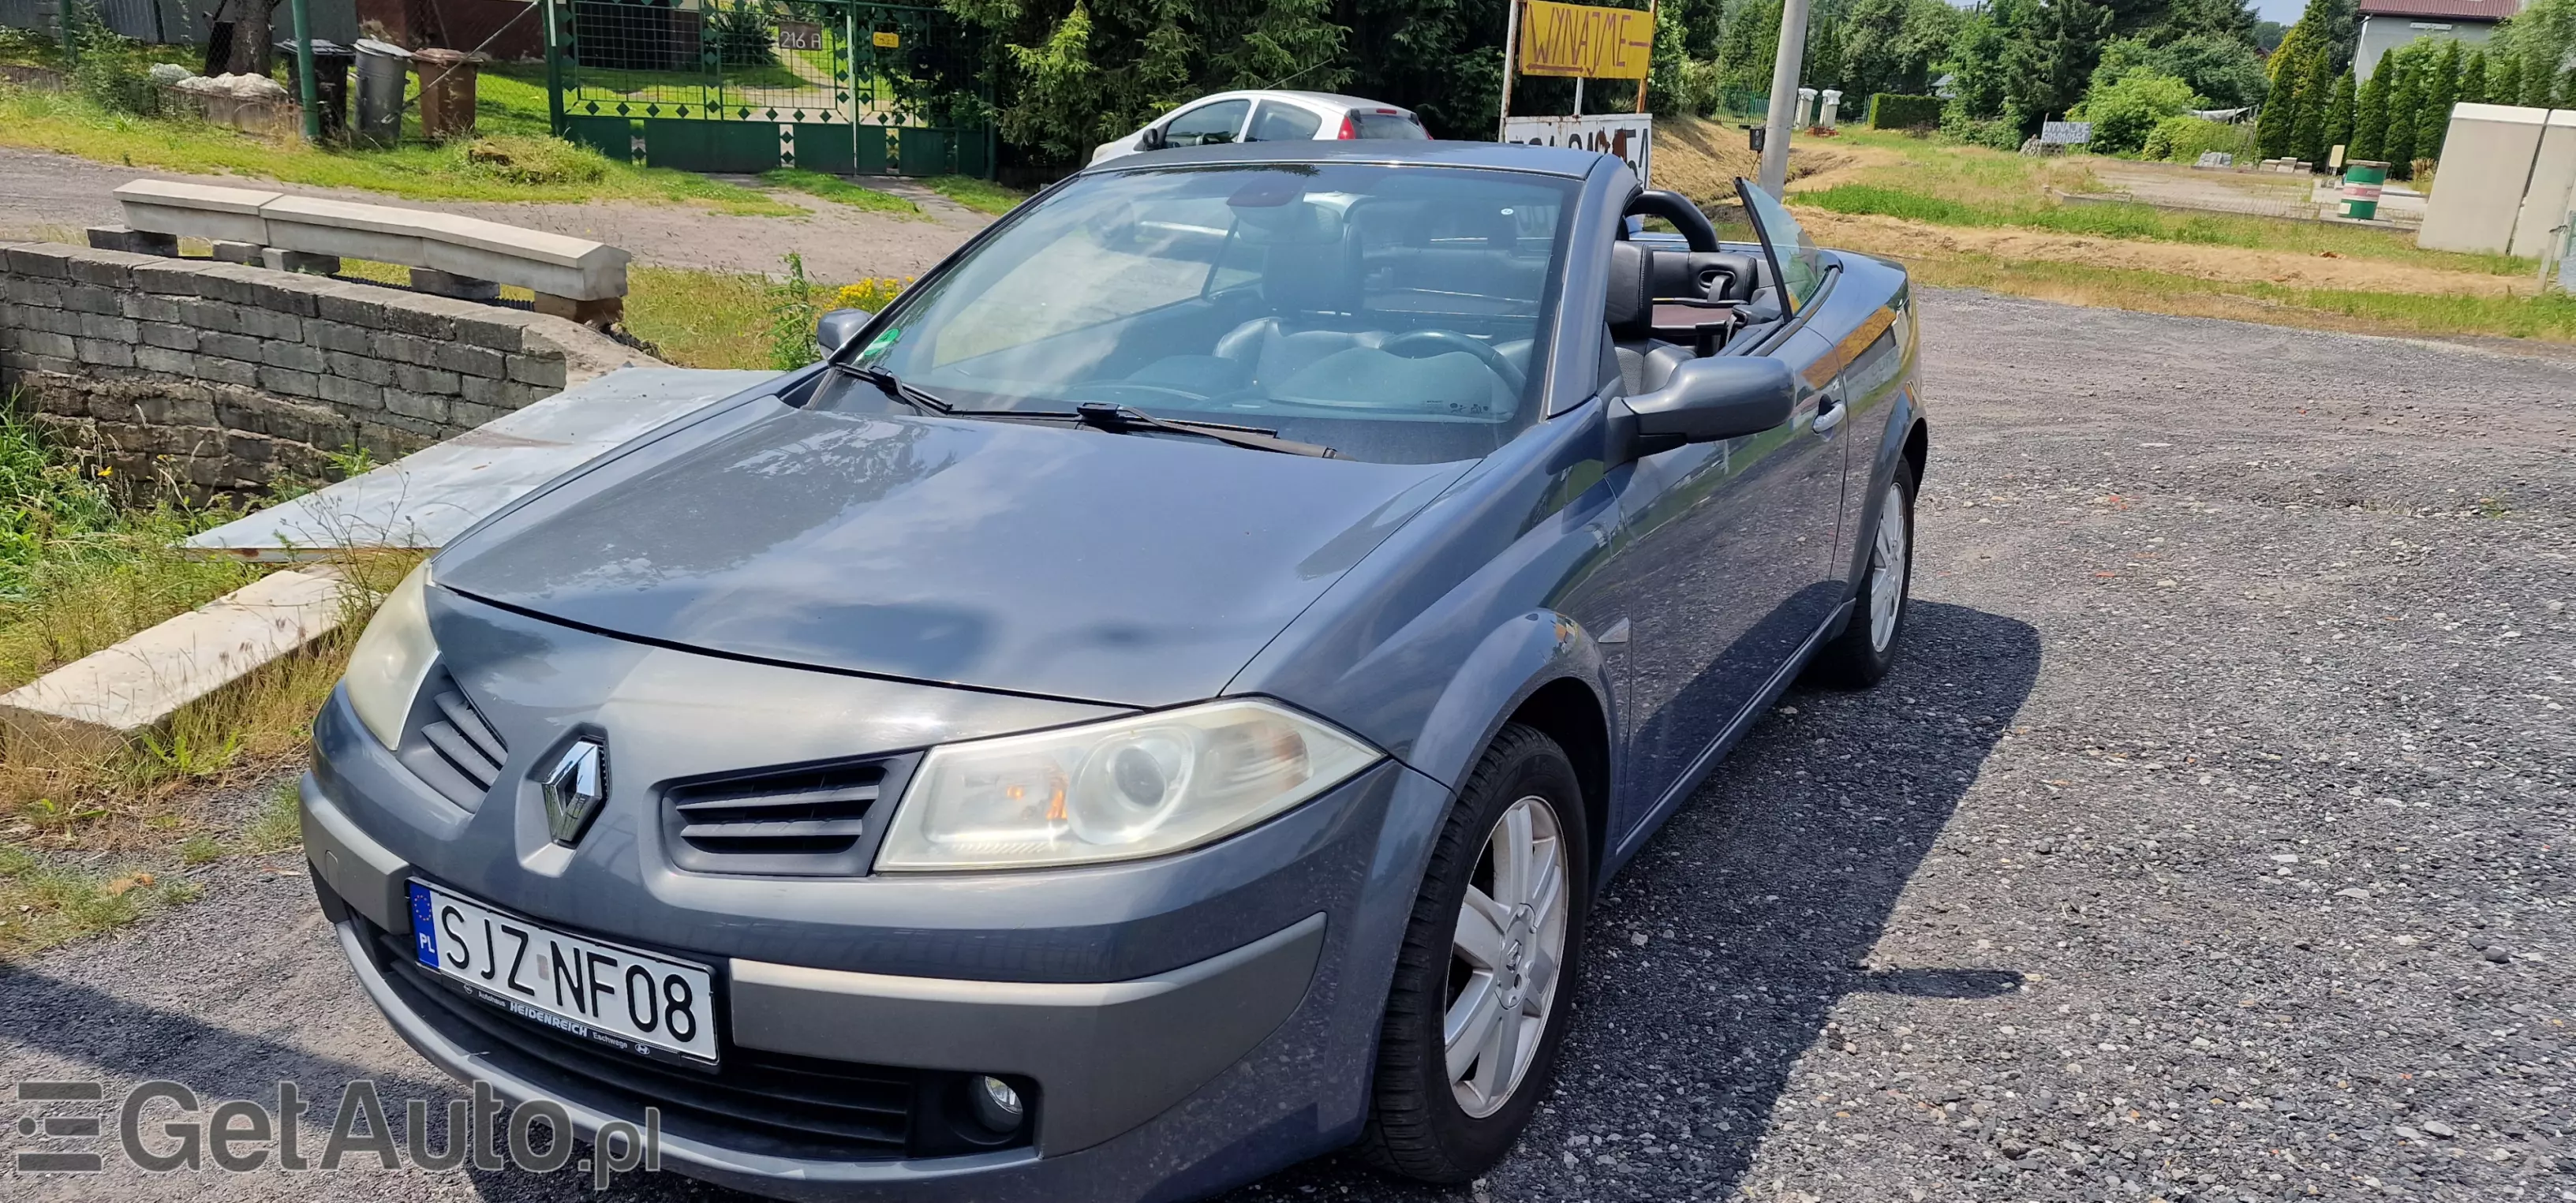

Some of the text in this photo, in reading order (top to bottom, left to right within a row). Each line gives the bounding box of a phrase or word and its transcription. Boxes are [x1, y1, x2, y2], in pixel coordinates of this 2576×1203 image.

[780, 31, 821, 50] 216 A
[419, 932, 436, 954] PL
[441, 905, 697, 1043] SJZ NF08
[478, 990, 628, 1050] Autohaus HEIDENREICH Eschwege
